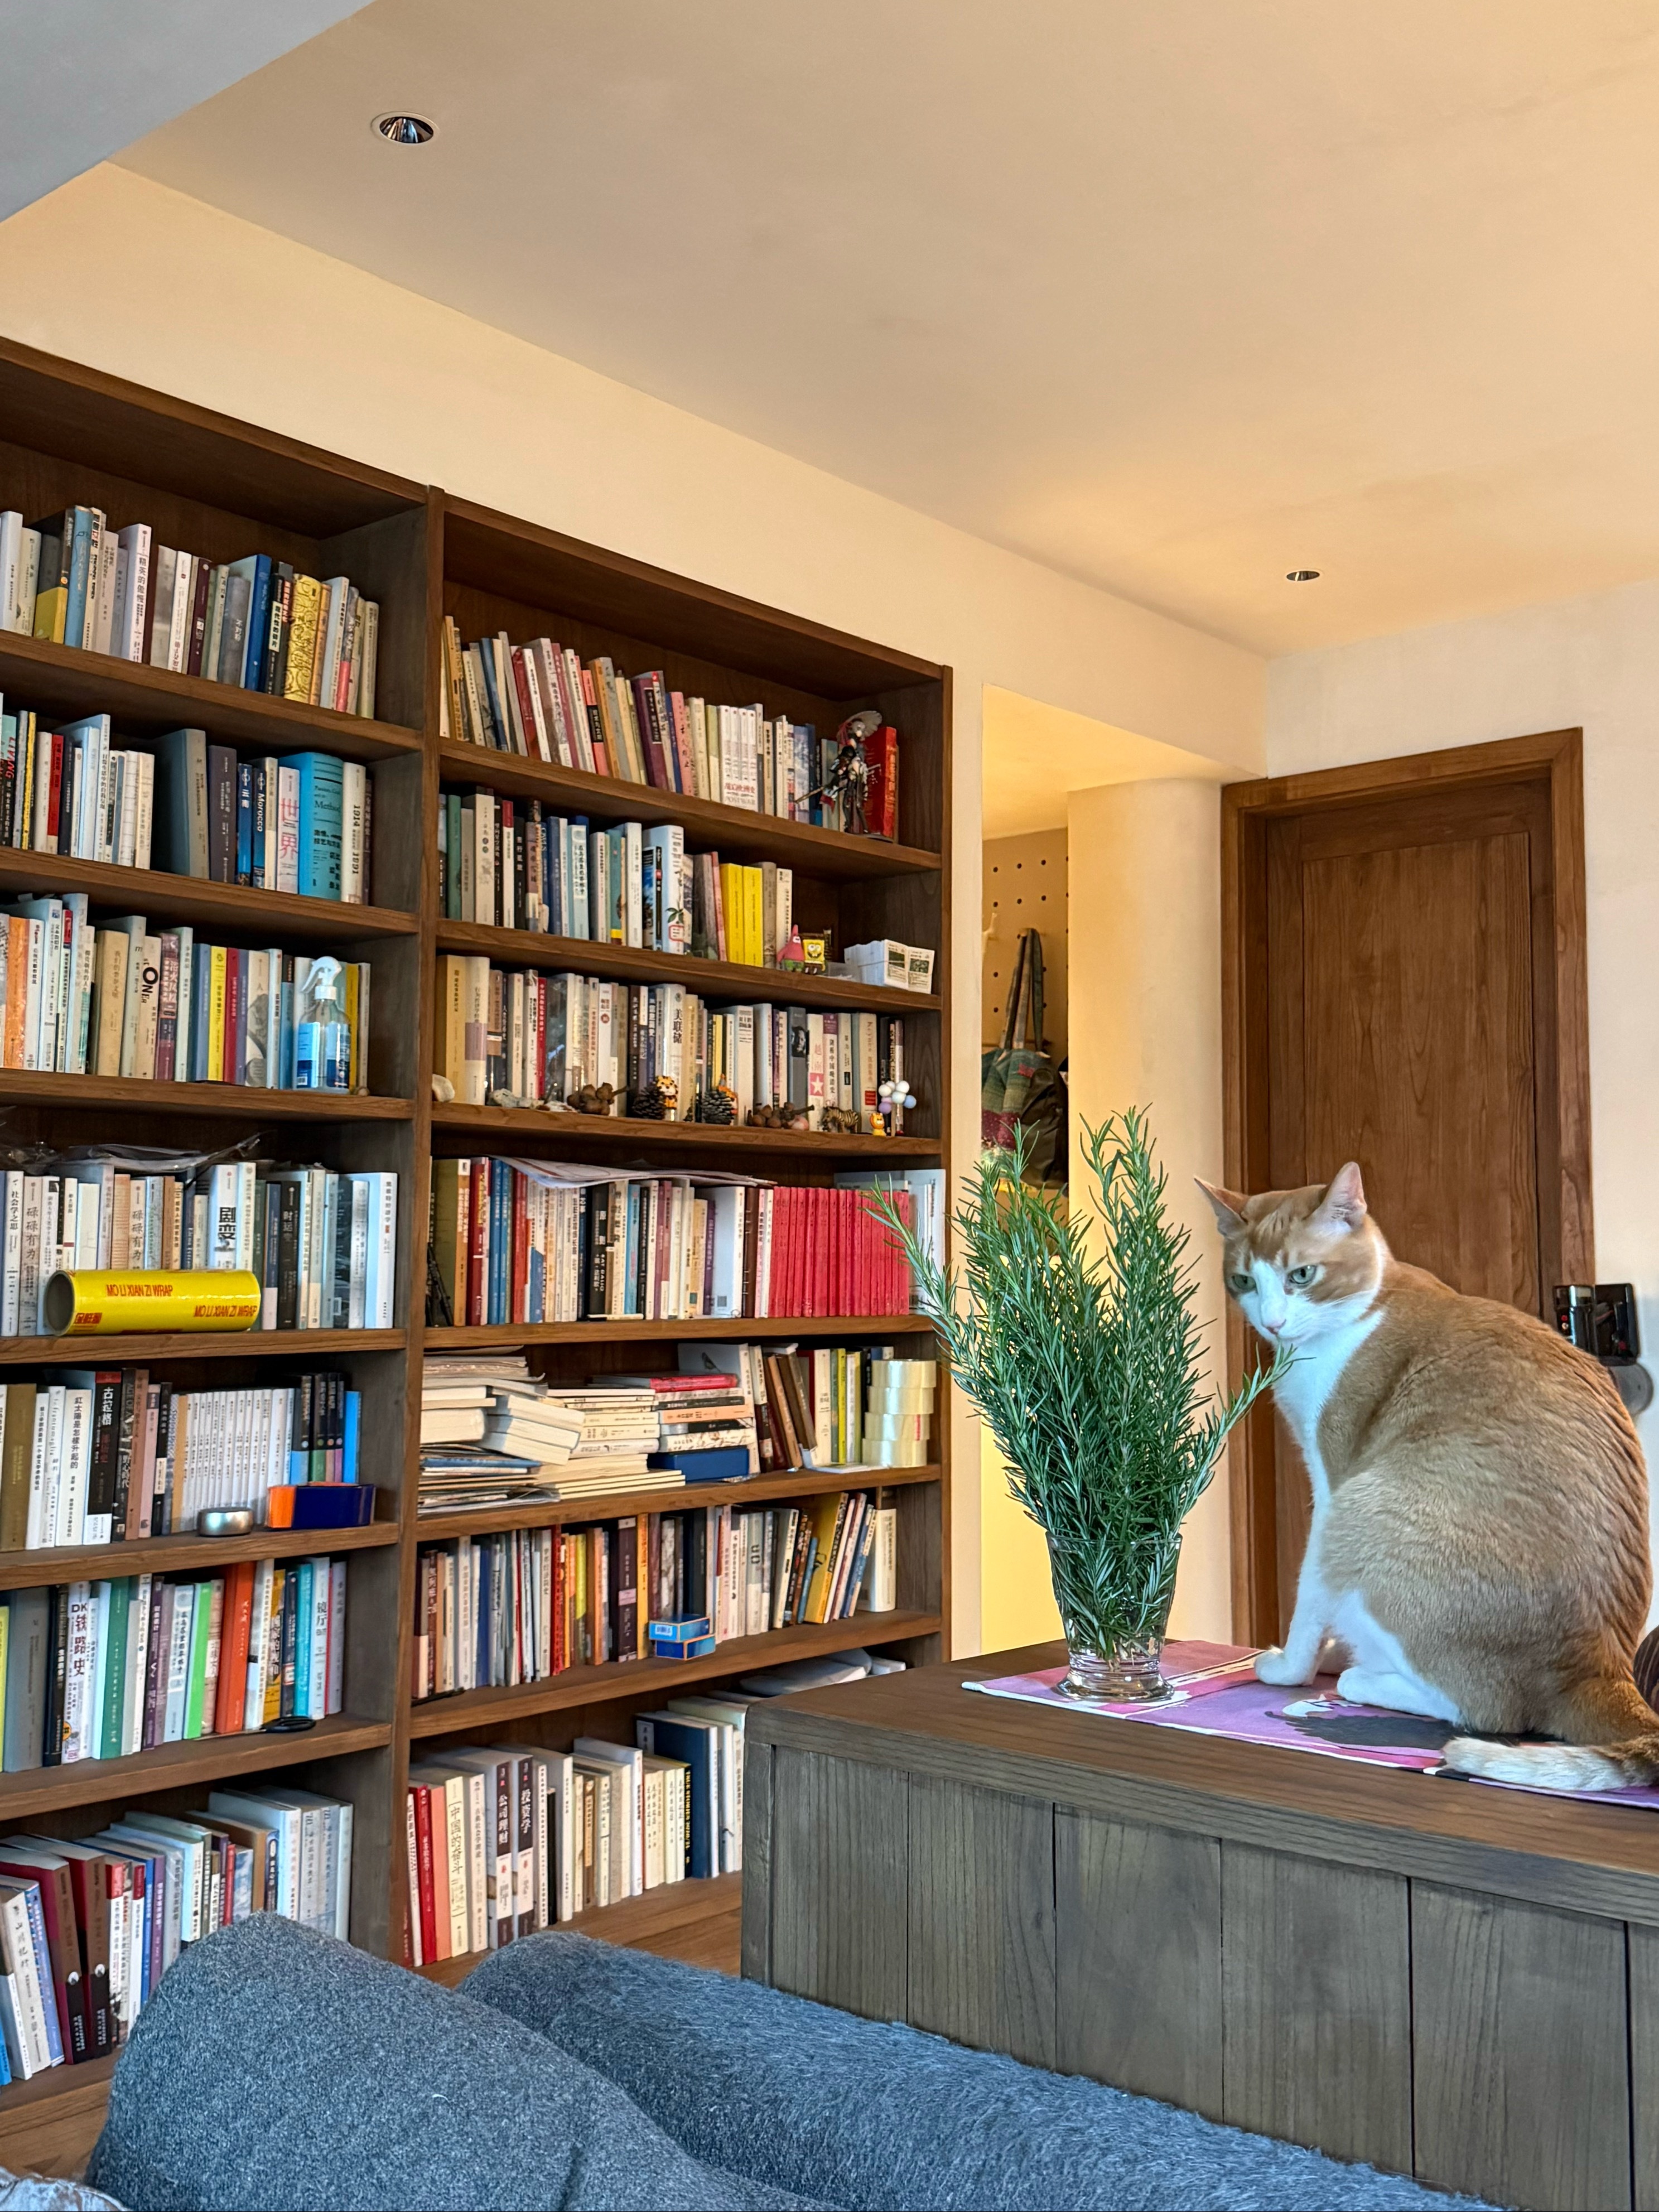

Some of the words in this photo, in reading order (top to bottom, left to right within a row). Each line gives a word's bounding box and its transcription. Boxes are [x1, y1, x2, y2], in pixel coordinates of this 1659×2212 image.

[673, 1008, 683, 1044] 美联储
[219, 1206, 237, 1240] 剧变
[102, 1387, 114, 1426] 古拉格
[71, 1603, 87, 1613] DK
[73, 1613, 86, 1677] 铁路史
[498, 1794, 508, 1845] 公司理财
